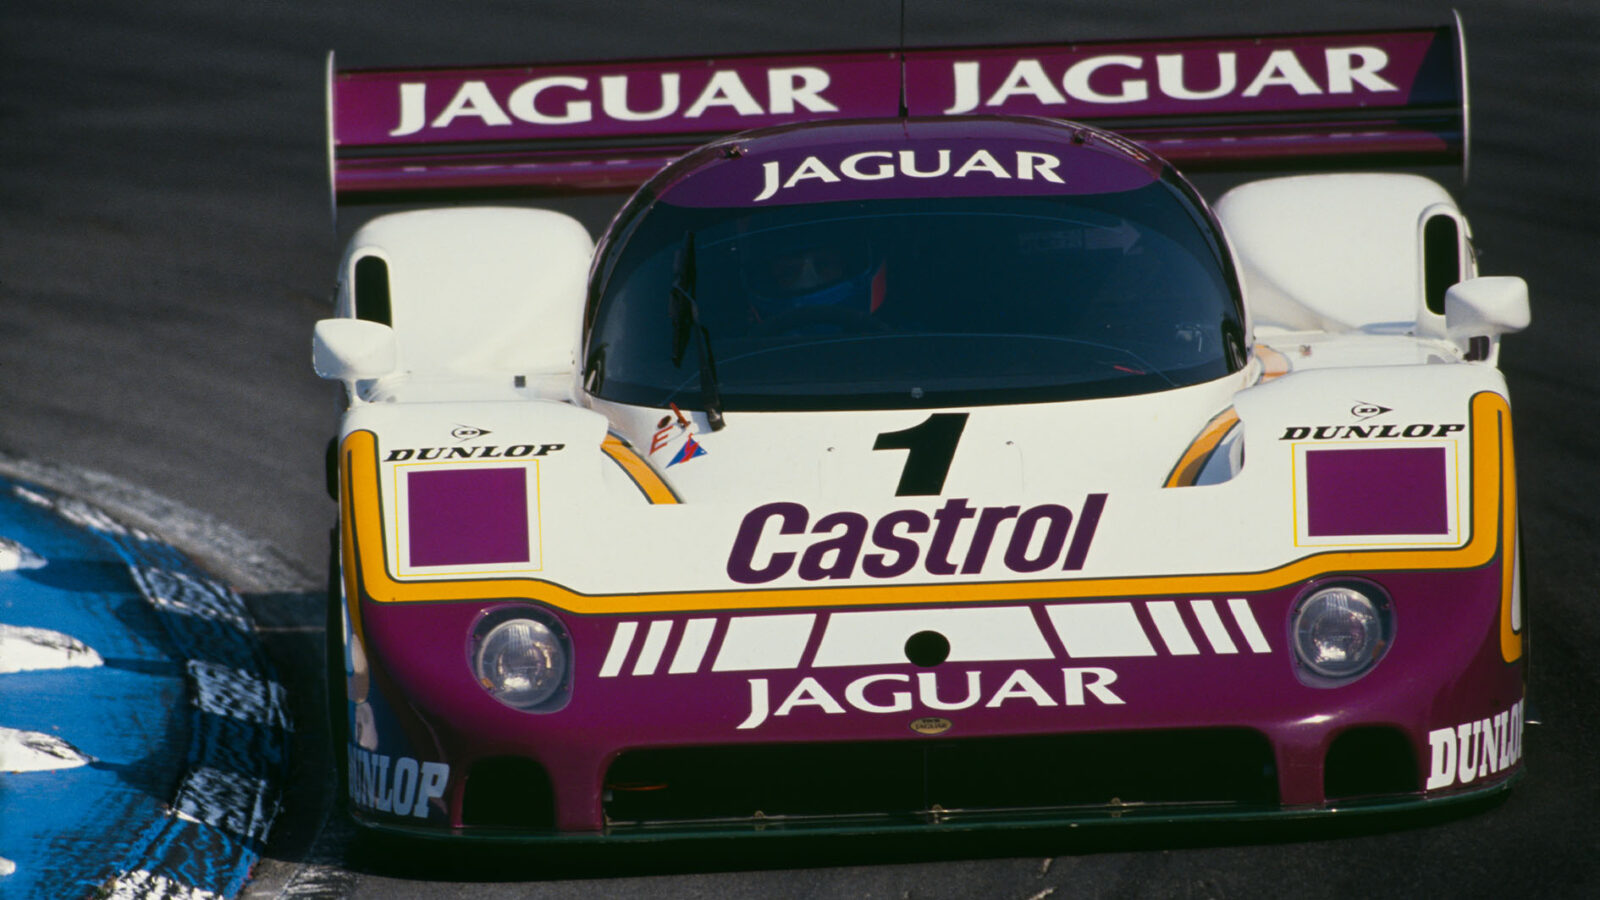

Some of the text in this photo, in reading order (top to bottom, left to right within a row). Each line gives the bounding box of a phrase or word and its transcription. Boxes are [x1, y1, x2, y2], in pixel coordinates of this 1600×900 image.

[388, 66, 840, 137] JAGUAR
[943, 46, 1399, 115] JAGUAR
[752, 149, 1066, 202] JAGUAR
[382, 443, 566, 462] DUNLOP
[871, 412, 970, 497] 1
[1278, 423, 1466, 441] DUNLOP
[726, 492, 1109, 585] Castrol
[735, 666, 1127, 730] JAGUAR
[347, 742, 450, 818] UNLOP
